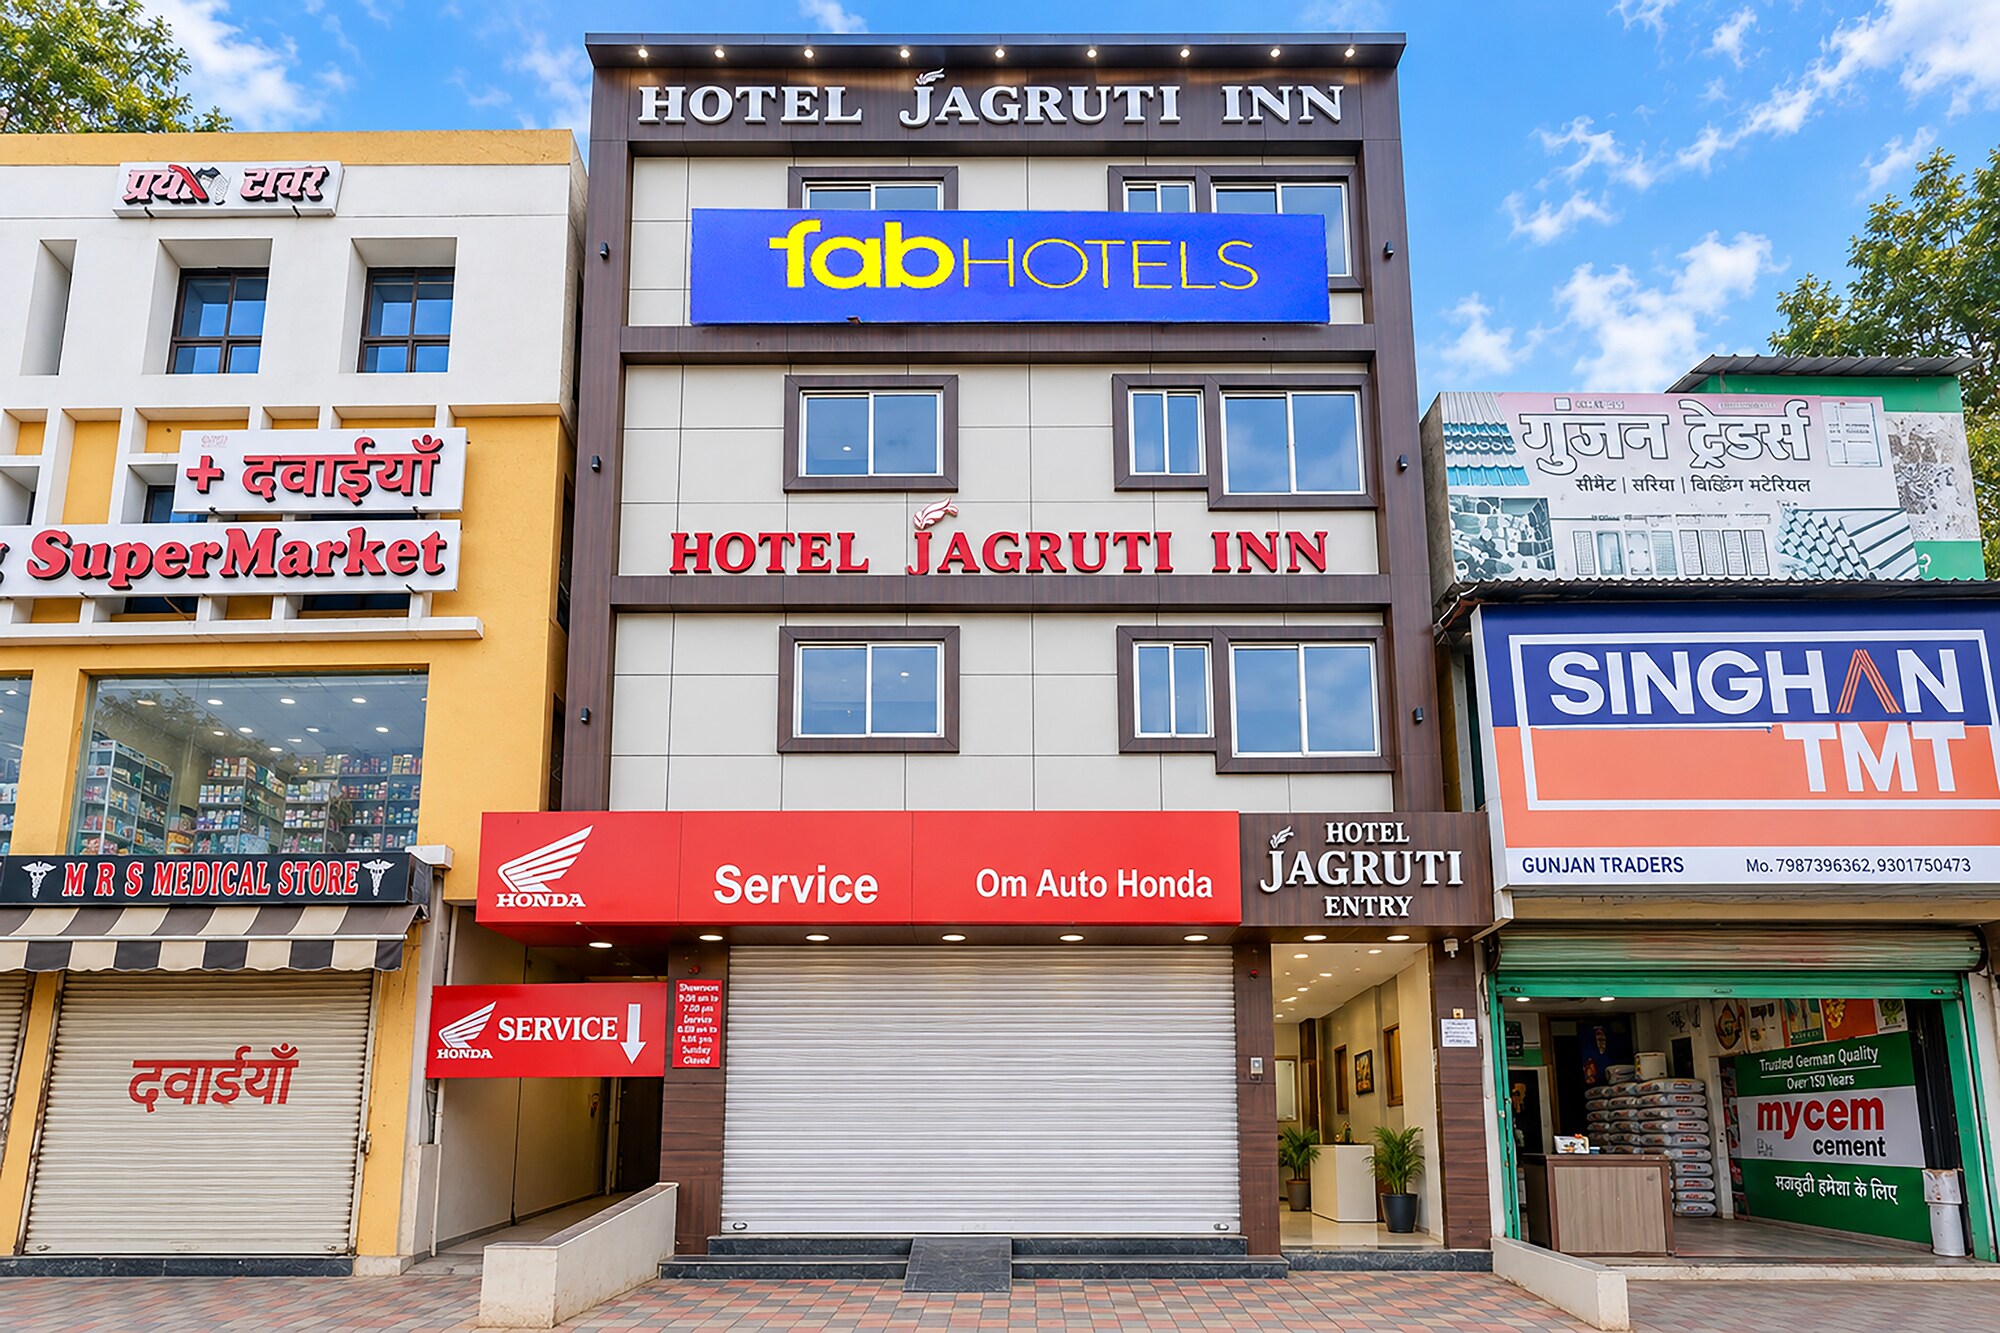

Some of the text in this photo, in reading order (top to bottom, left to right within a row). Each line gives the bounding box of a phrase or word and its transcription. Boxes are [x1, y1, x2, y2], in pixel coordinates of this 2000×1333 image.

[638, 85, 1344, 128] HOTEL JAGRUTI INN
[242, 434, 444, 506] दवाईयाँ
[27, 527, 448, 590] SuperMarket
[669, 531, 1328, 576] HOTEL JAGRUTI INN
[1548, 649, 1965, 716] SINGHAN
[1782, 721, 1966, 792] TMT
[1325, 822, 1410, 843] HOTEL
[62, 861, 359, 896] M R S MEDICAL STORE
[1260, 850, 1464, 893] JAGRUTI
[1522, 857, 1684, 874] GUNJAN TRADERS
[1746, 857, 1772, 873] Mo.
[713, 864, 878, 904] Service
[976, 868, 1213, 898] Om Auto Honda
[496, 892, 586, 908] HONDA
[1324, 896, 1412, 918] ENTRY
[498, 1016, 618, 1041] SERVICE
[436, 1048, 493, 1059] HONDA
[1795, 1053, 1836, 1069] German
[1838, 1045, 1879, 1066] Quality
[128, 1042, 300, 1113] दवाईयाँ
[1786, 1077, 1809, 1090] Over
[1827, 1074, 1855, 1087] Years
[1757, 1096, 1885, 1140] mycem
[1812, 1136, 1887, 1157] cement
[1818, 1174, 1851, 1197] हमेशा
[1853, 1176, 1867, 1198] के
[1871, 1178, 1899, 1205] लिए
